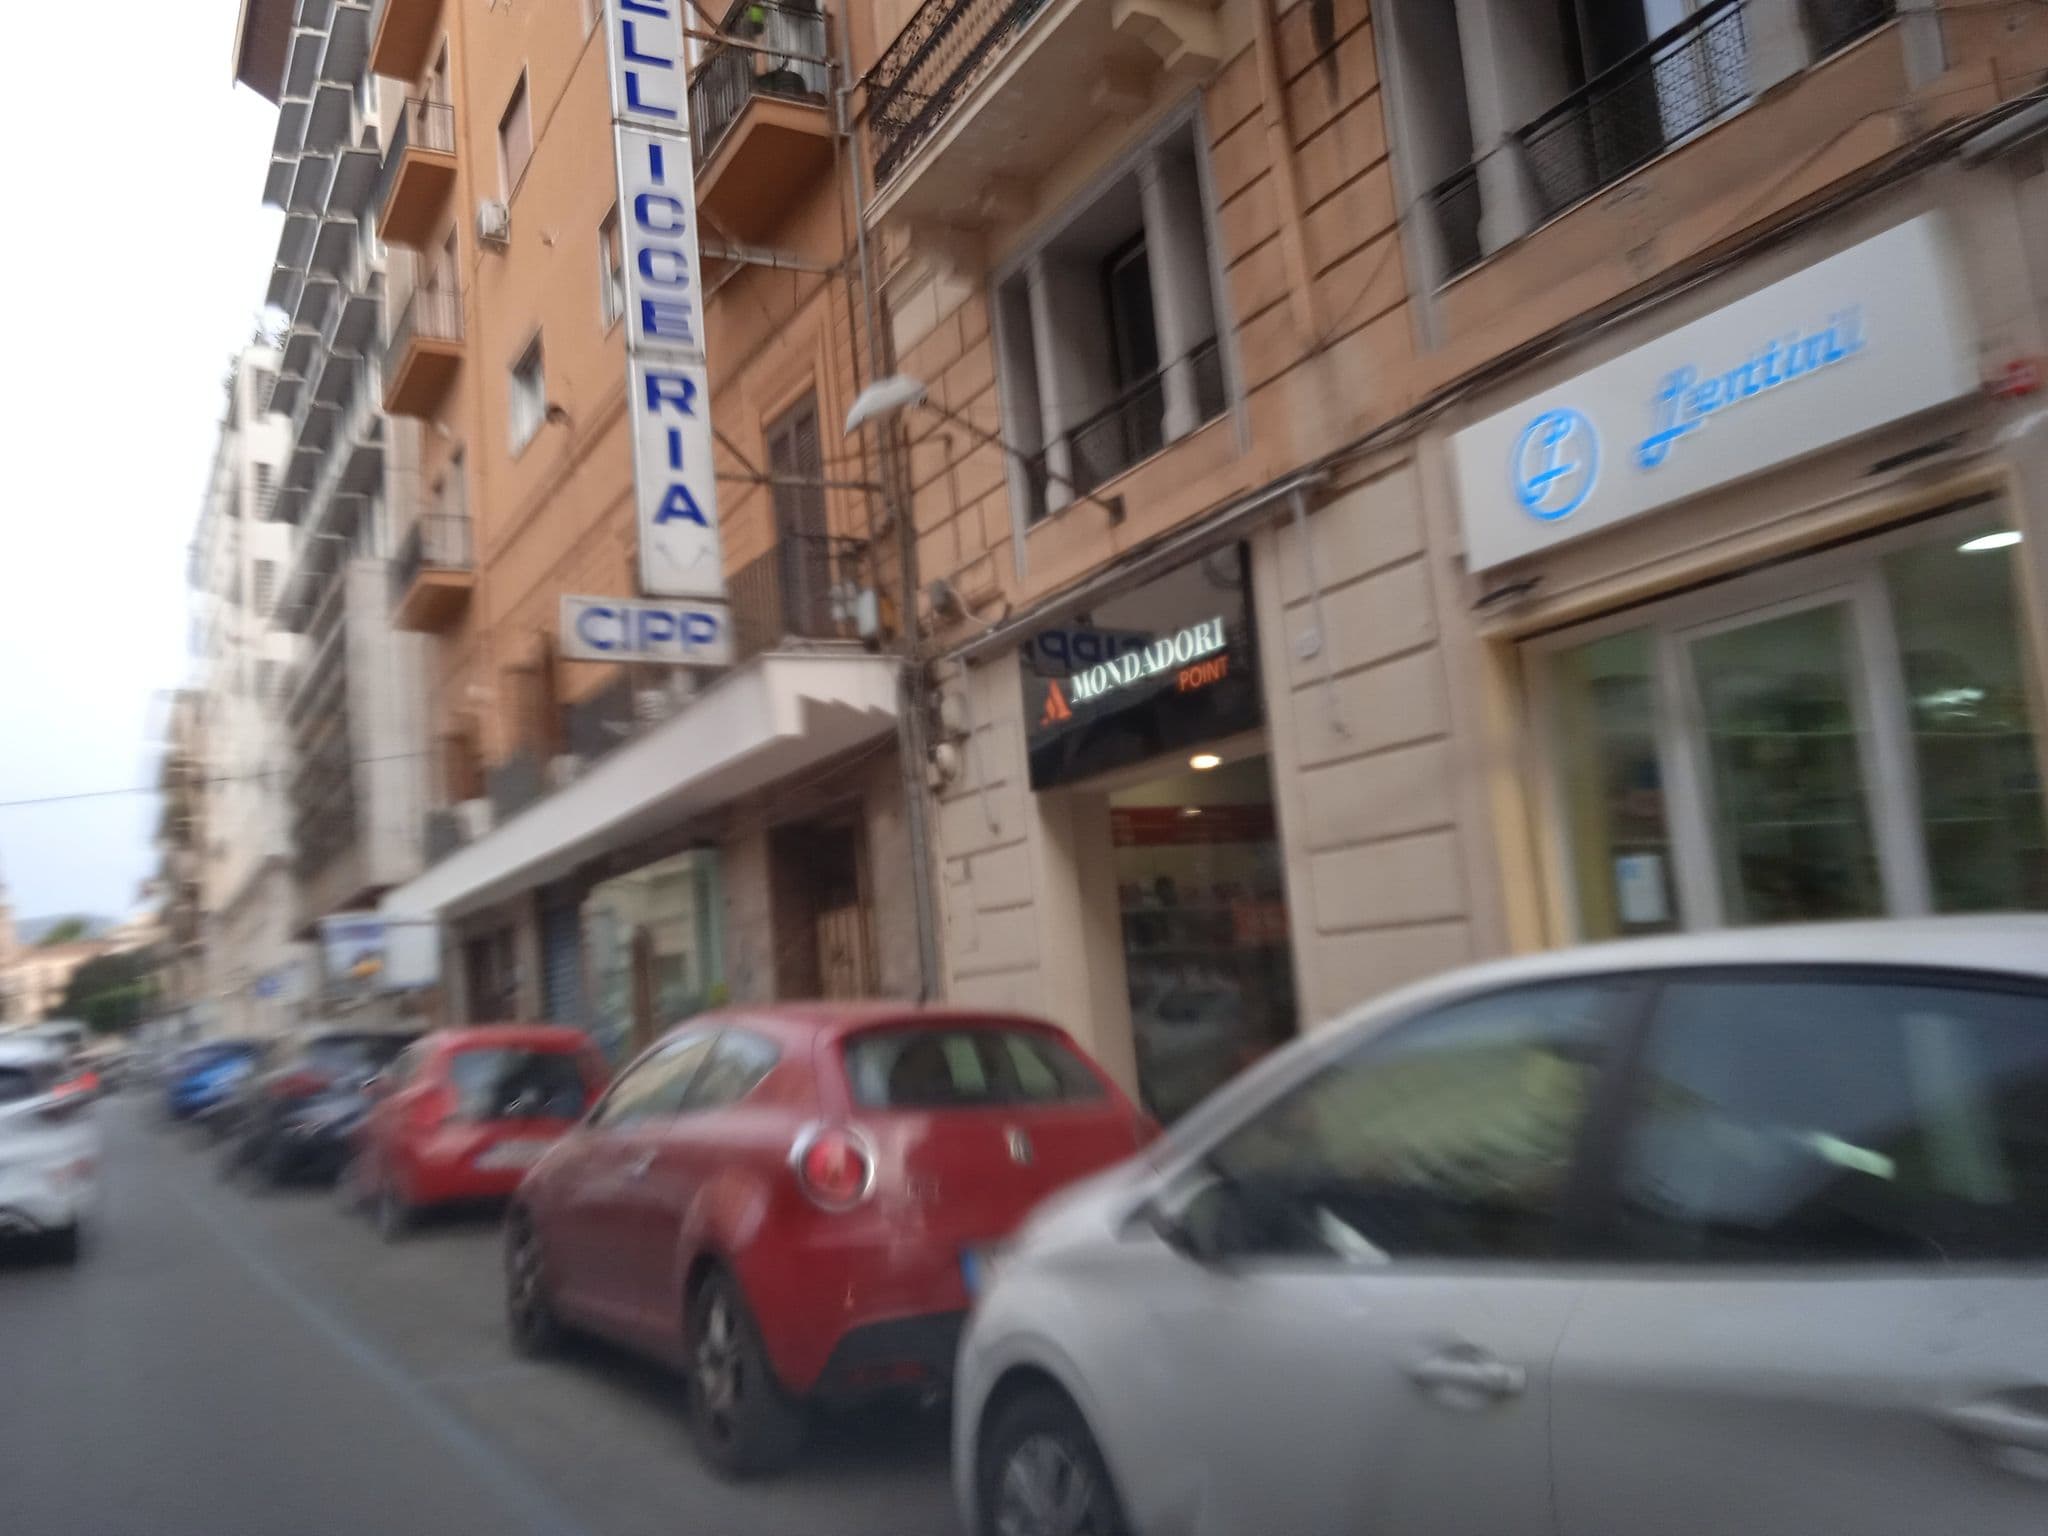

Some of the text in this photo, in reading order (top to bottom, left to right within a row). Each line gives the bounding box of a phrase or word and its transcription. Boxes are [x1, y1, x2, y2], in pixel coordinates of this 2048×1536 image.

[576, 607, 718, 652] CIPP
[1072, 617, 1226, 702] MONDADORI
[1178, 656, 1229, 692] POINT
